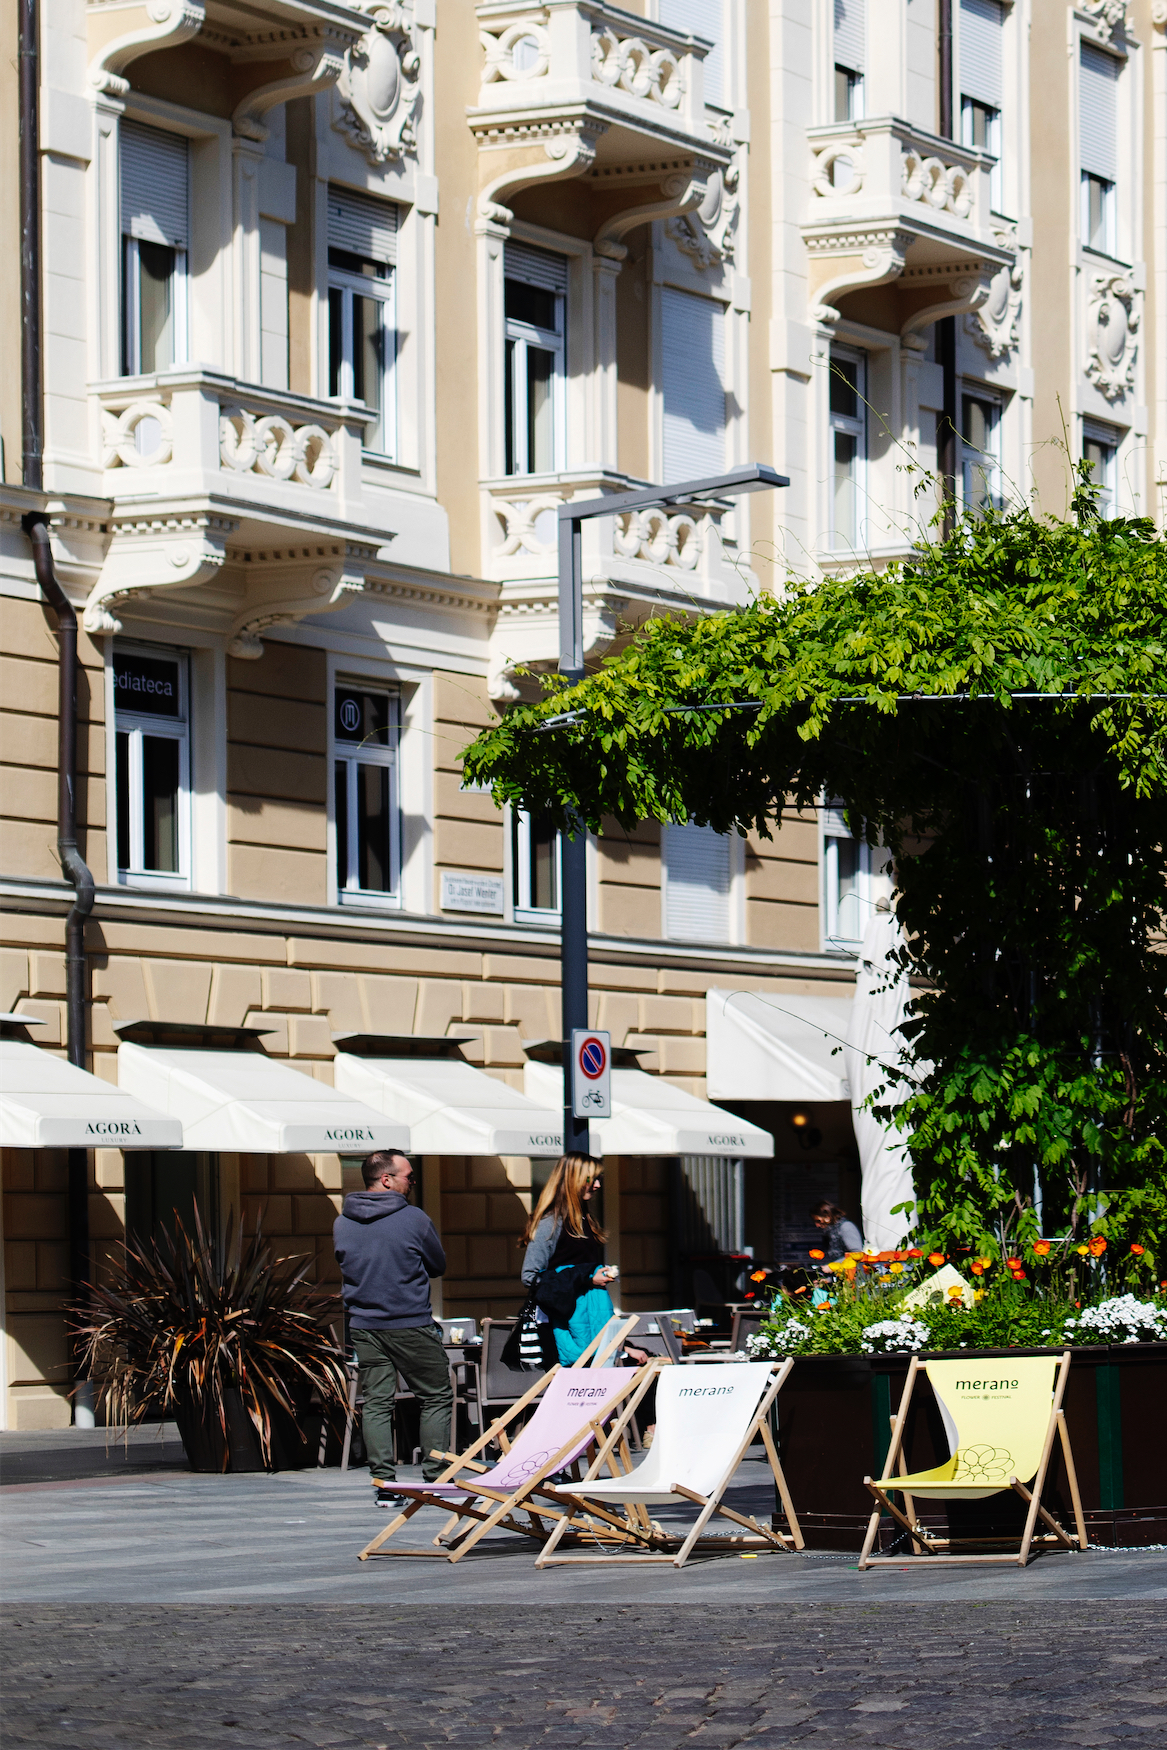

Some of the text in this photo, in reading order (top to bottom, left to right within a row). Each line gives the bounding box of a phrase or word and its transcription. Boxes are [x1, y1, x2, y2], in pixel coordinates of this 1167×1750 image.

[113, 671, 173, 696] ediateca
[85, 1120, 142, 1135] AGORÀ
[324, 1126, 374, 1140] AGORÀ
[528, 1135, 564, 1146] AGOR
[707, 1134, 746, 1146] AGORÀ
